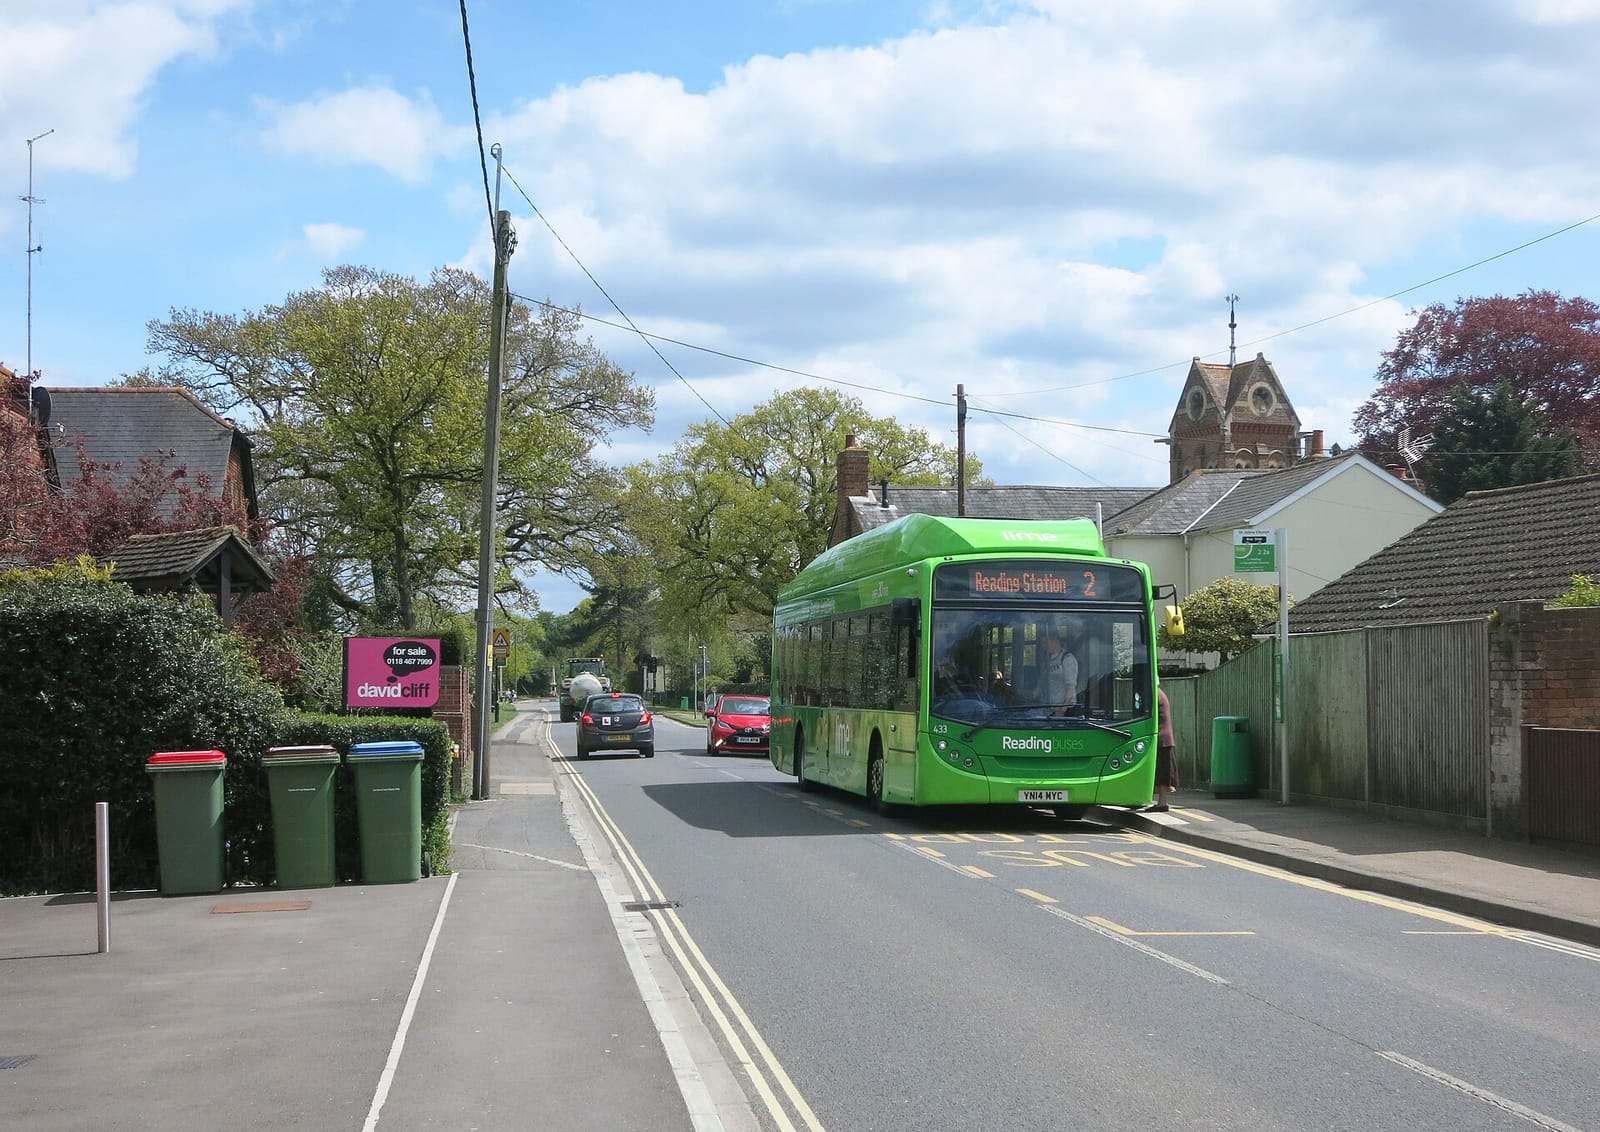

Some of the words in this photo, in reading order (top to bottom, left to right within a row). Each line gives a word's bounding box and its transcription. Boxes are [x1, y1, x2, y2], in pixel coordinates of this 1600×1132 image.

[1001, 530, 1057, 542] lime
[976, 572, 1020, 592] Reading
[1023, 573, 1066, 593] Station
[1084, 572, 1096, 596] 2
[392, 646, 406, 656] for
[408, 646, 426, 655] sale
[933, 725, 948, 734] 433
[1024, 792, 1043, 800] YN14
[1046, 792, 1063, 800] MYC
